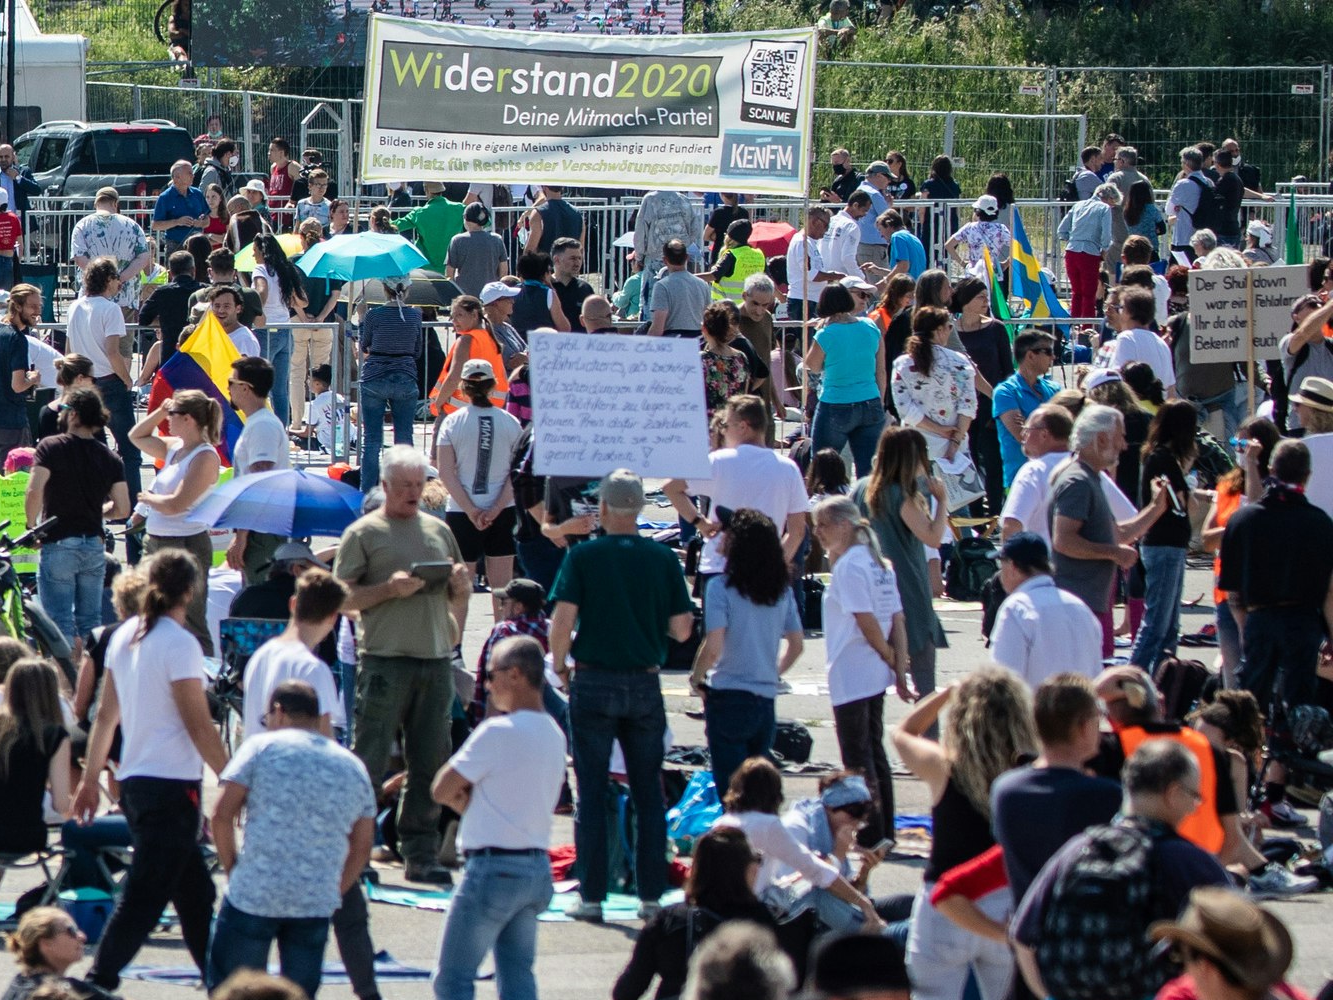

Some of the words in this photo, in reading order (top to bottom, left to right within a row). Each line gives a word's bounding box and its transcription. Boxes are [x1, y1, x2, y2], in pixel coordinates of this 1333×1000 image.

[389, 49, 712, 98] Widerstand2020
[503, 104, 559, 127] Deine
[564, 105, 713, 127] Mitmach-Partei
[749, 107, 774, 121] SCAN
[776, 111, 791, 123] ME
[379, 136, 415, 148] Bilden
[418, 138, 434, 148] Sie
[437, 139, 457, 150] sich
[461, 140, 482, 151] Ihre
[484, 142, 518, 154] eigene
[521, 142, 570, 154] Meinung
[580, 142, 644, 155] Unabhängig
[646, 143, 666, 154] und
[669, 144, 712, 155] Fundiert
[372, 153, 406, 169] Kein
[410, 156, 445, 171] Platz
[448, 157, 469, 171] für
[473, 158, 522, 172] Rechts
[525, 158, 559, 172] oder
[562, 159, 719, 175] Verschwörungsspinner
[1195, 276, 1217, 291] Der
[1205, 300, 1229, 310] war
[1231, 297, 1247, 309] ein
[1194, 315, 1211, 330] Ihr
[1213, 316, 1226, 329] da
[1194, 335, 1240, 351] Bekennt
